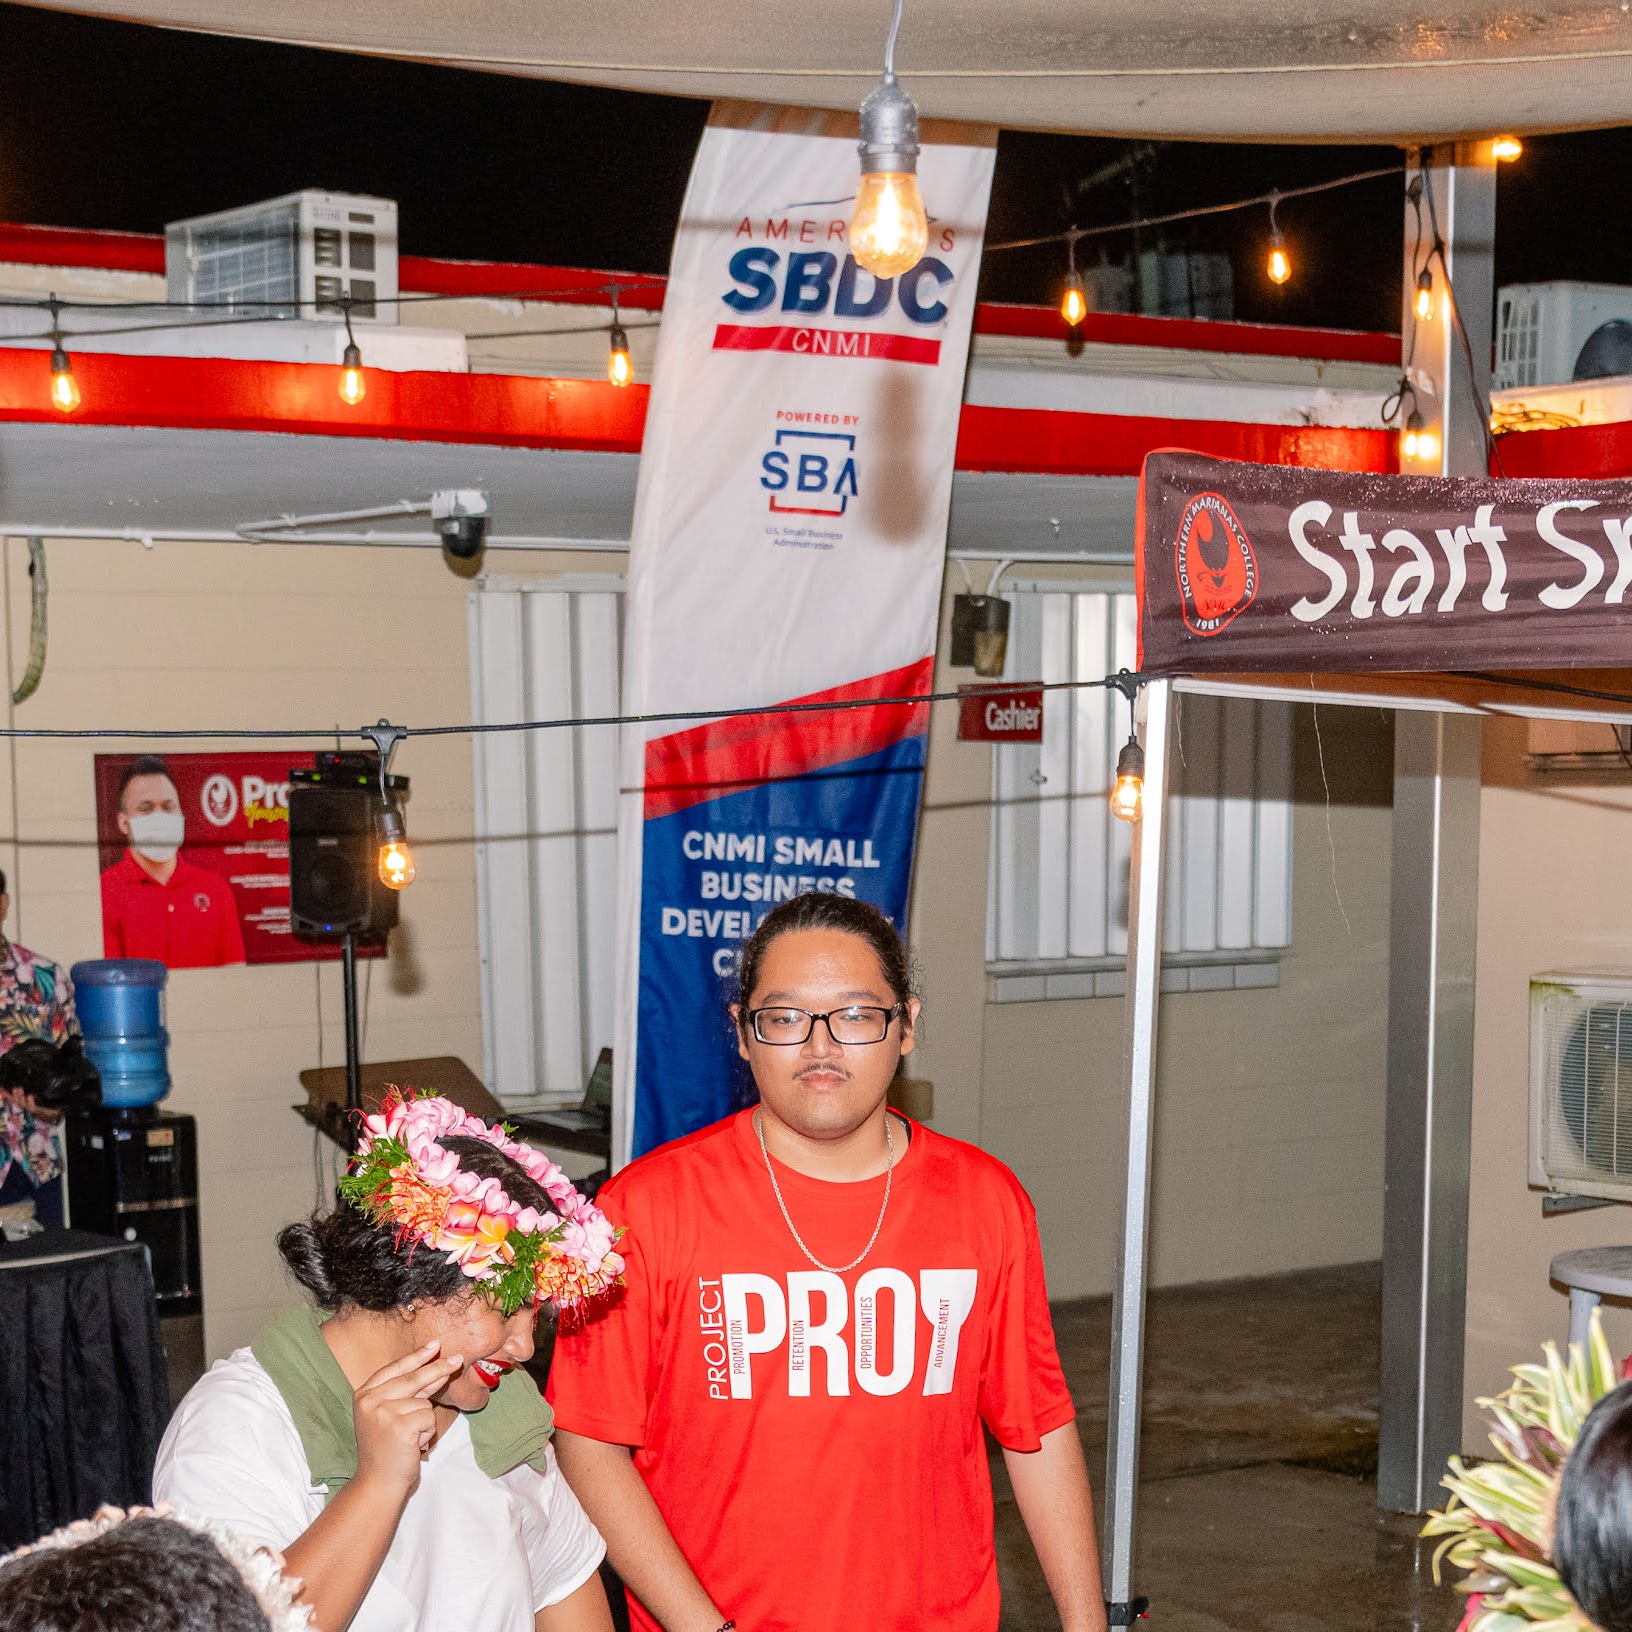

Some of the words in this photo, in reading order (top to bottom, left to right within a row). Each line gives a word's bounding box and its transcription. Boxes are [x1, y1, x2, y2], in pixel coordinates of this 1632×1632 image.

[721, 247, 955, 327] SBDC
[792, 330, 871, 357] CNMI
[776, 410, 839, 425] POWERED
[843, 415, 859, 426] BY
[760, 451, 858, 496] SBA
[1179, 513, 1194, 598] NORTHERN
[1237, 535, 1255, 598] COLLEGE
[1288, 500, 1509, 622] Start
[1196, 619, 1220, 631] 1981
[985, 699, 1042, 731] Cashier
[683, 830, 765, 863] CNMI
[774, 835, 881, 868] SMALL
[701, 871, 856, 902] BUSINESS
[699, 1276, 729, 1400] PROJECT
[730, 1319, 746, 1375] PROMOTION
[792, 1319, 805, 1371] RETENTION
[860, 1296, 873, 1370] OPPORTUNITIES
[933, 1297, 950, 1368] ADVANCEMENT
